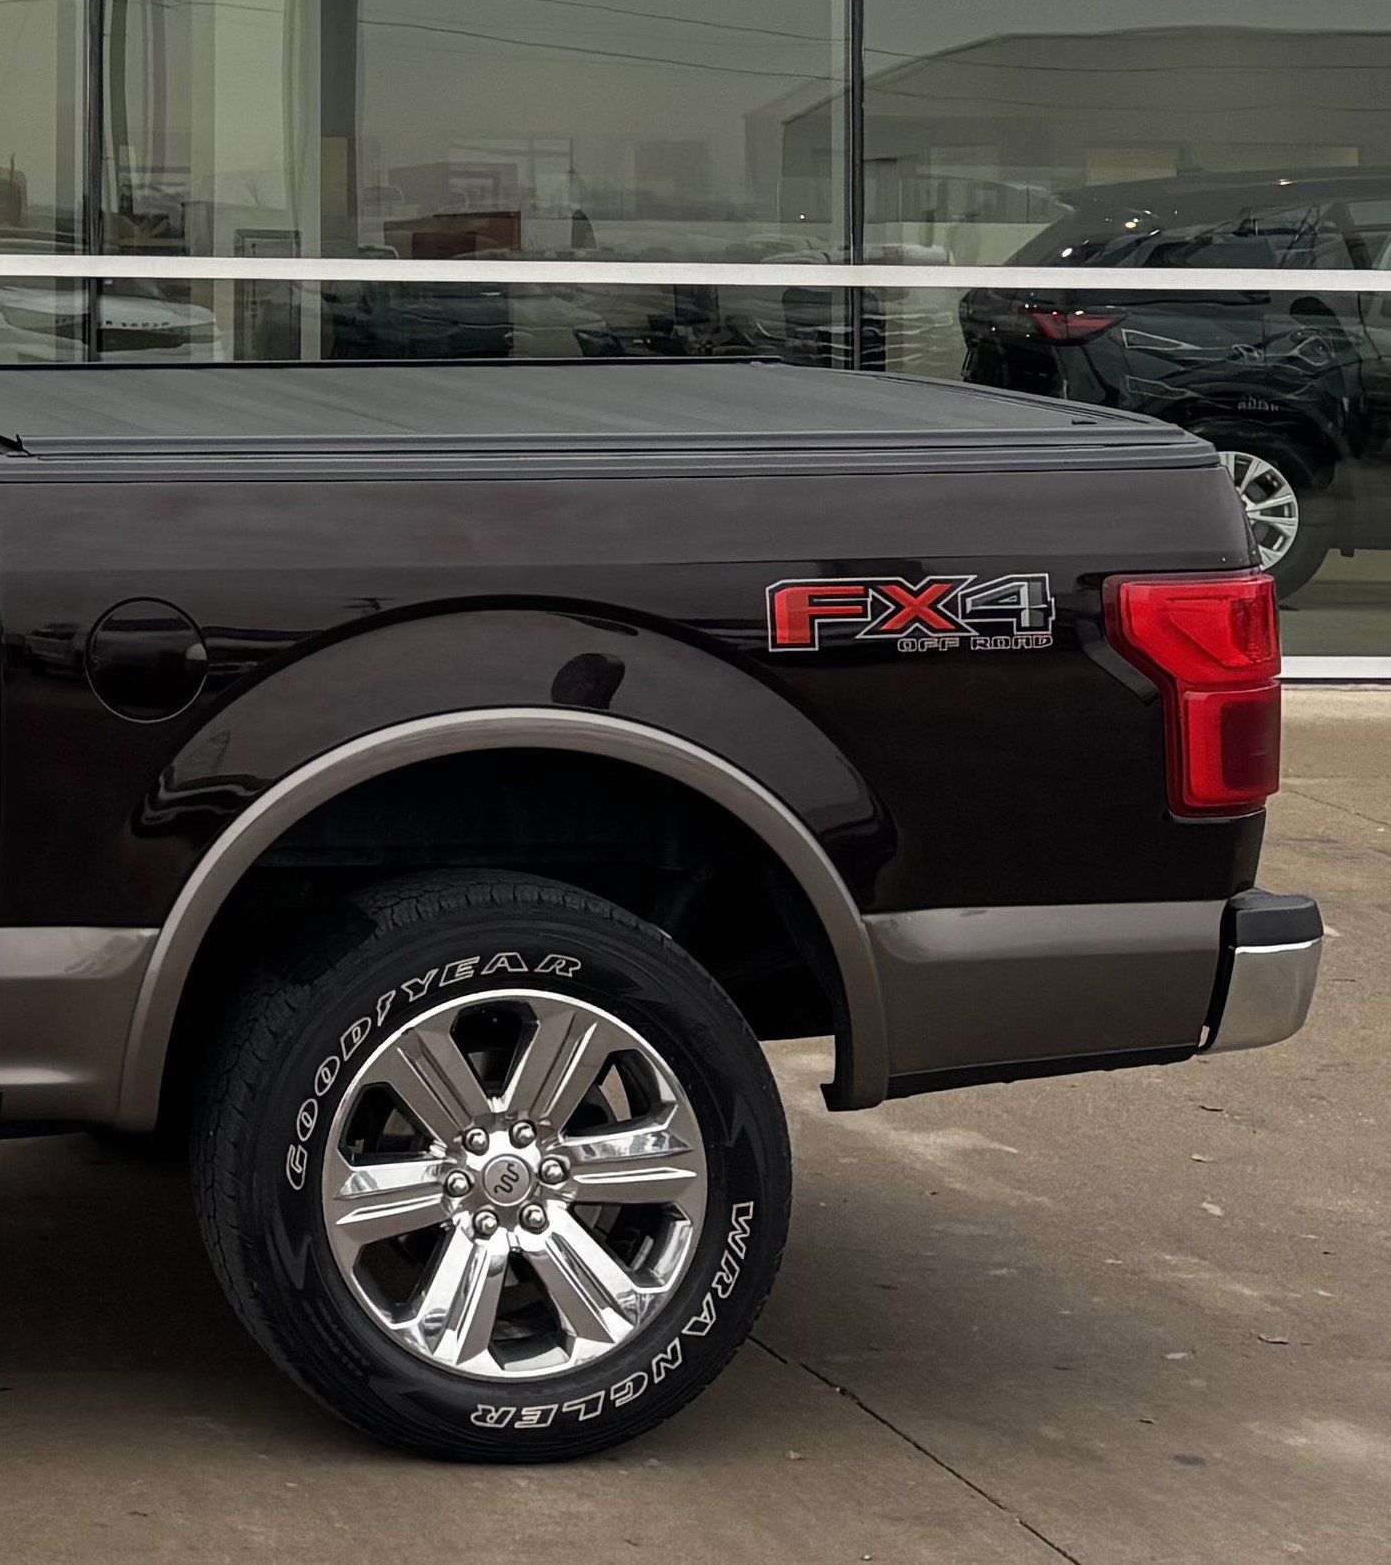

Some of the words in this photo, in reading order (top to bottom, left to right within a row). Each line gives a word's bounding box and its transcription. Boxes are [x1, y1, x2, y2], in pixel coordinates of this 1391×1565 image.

[766, 573, 1055, 652] FX4
[898, 637, 959, 652] OFF
[971, 636, 1053, 650] ROAD
[286, 952, 581, 1190] GOODYEAR
[471, 1202, 754, 1428] WRANGLER
